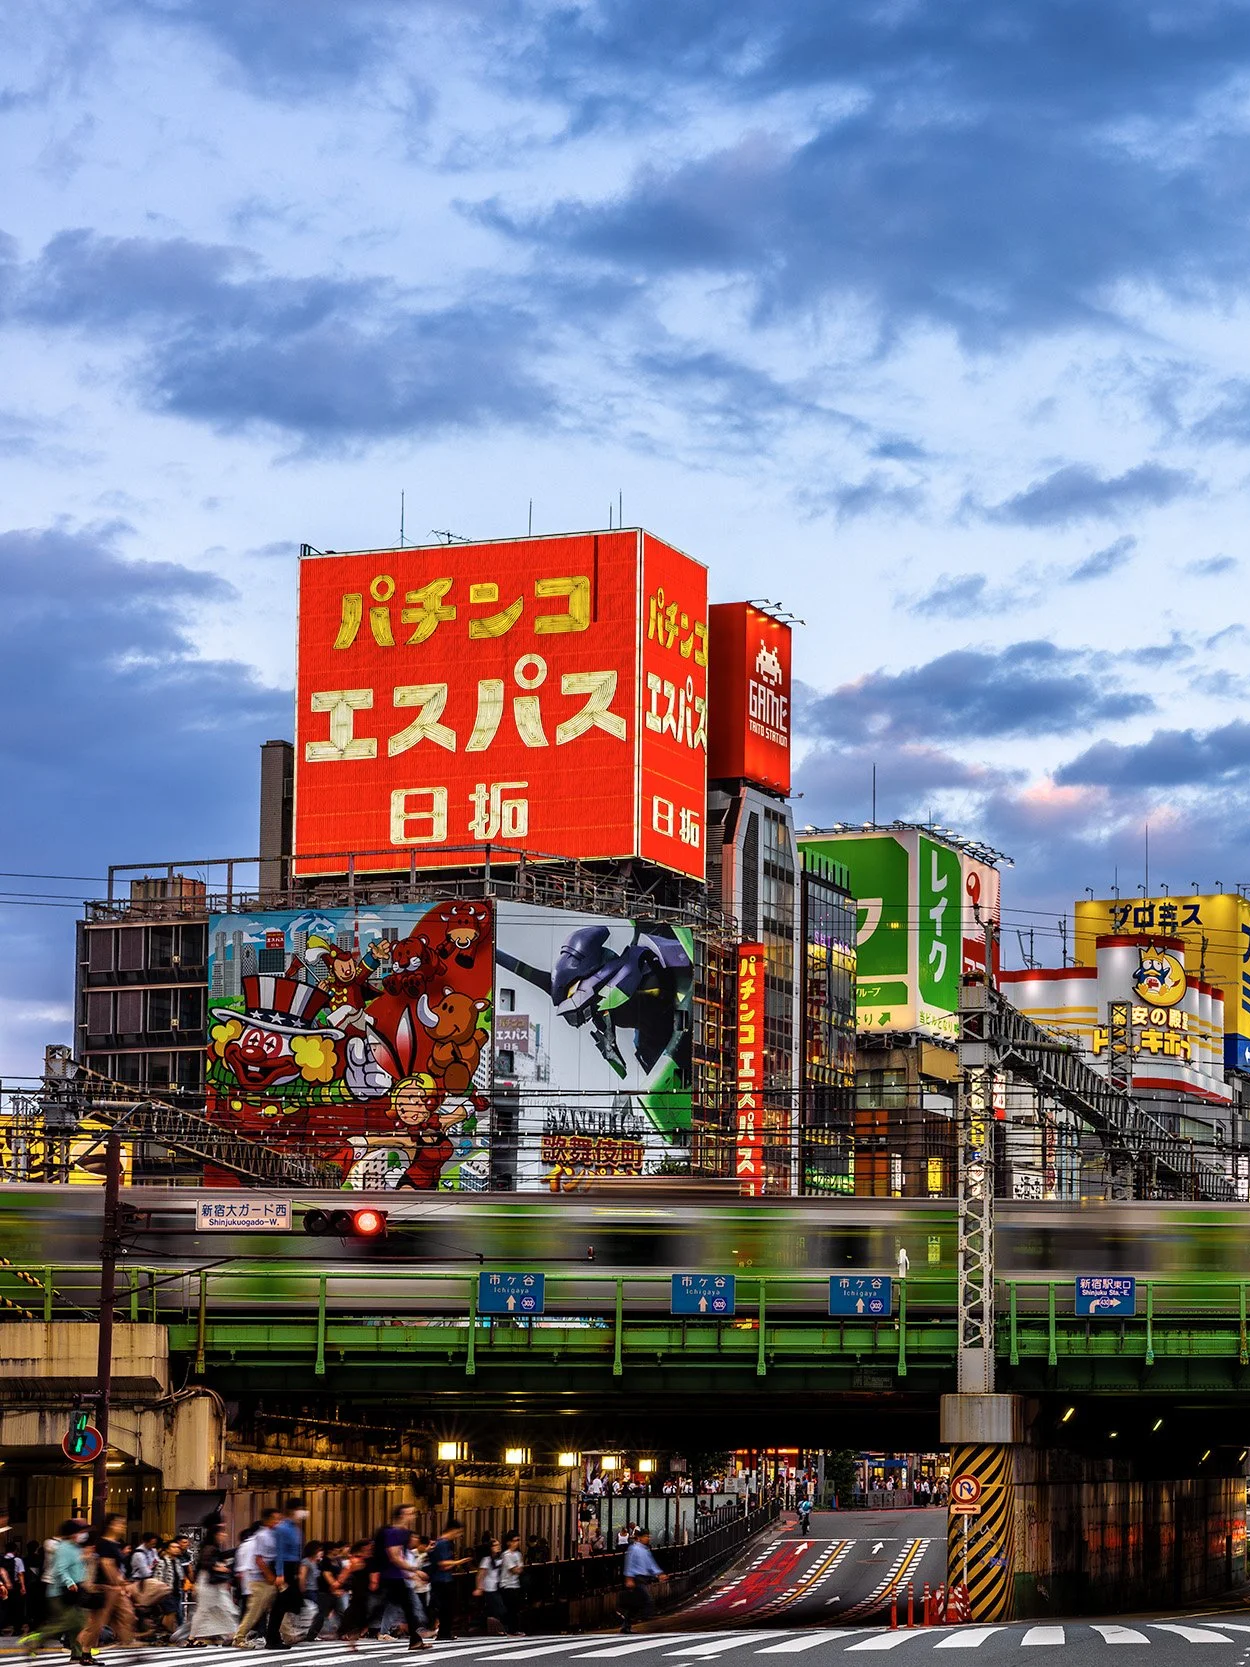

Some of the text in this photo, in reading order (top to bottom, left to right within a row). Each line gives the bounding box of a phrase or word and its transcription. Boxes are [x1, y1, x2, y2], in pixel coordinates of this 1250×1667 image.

[332, 574, 591, 650] パチンコ
[646, 586, 708, 668] パチンコ
[304, 653, 628, 764] エスパス
[645, 674, 708, 755] エスパス
[749, 679, 788, 734] GAME
[749, 719, 788, 749] TAITO STATION
[389, 780, 529, 845] 日拓
[652, 794, 700, 849] 日拓
[929, 849, 949, 984] レイク
[1108, 903, 1203, 930] プロミス
[738, 955, 756, 1045] パチンコ
[496, 1028, 528, 1040] エスパス
[737, 1050, 756, 1175] エスパス
[540, 1134, 645, 1169] 歌舞伎町
[201, 1203, 287, 1218] 新宿大ガード西
[208, 1217, 280, 1228] Shinjukuogado-W.
[493, 1286, 530, 1295] Ichigaya
[686, 1288, 721, 1296] Ichigaya
[843, 1289, 879, 1297] Ichigaya
[1079, 1278, 1132, 1290] 新宿駅東口
[1081, 1289, 1108, 1297] Shinjuku
[521, 1299, 534, 1307] 302
